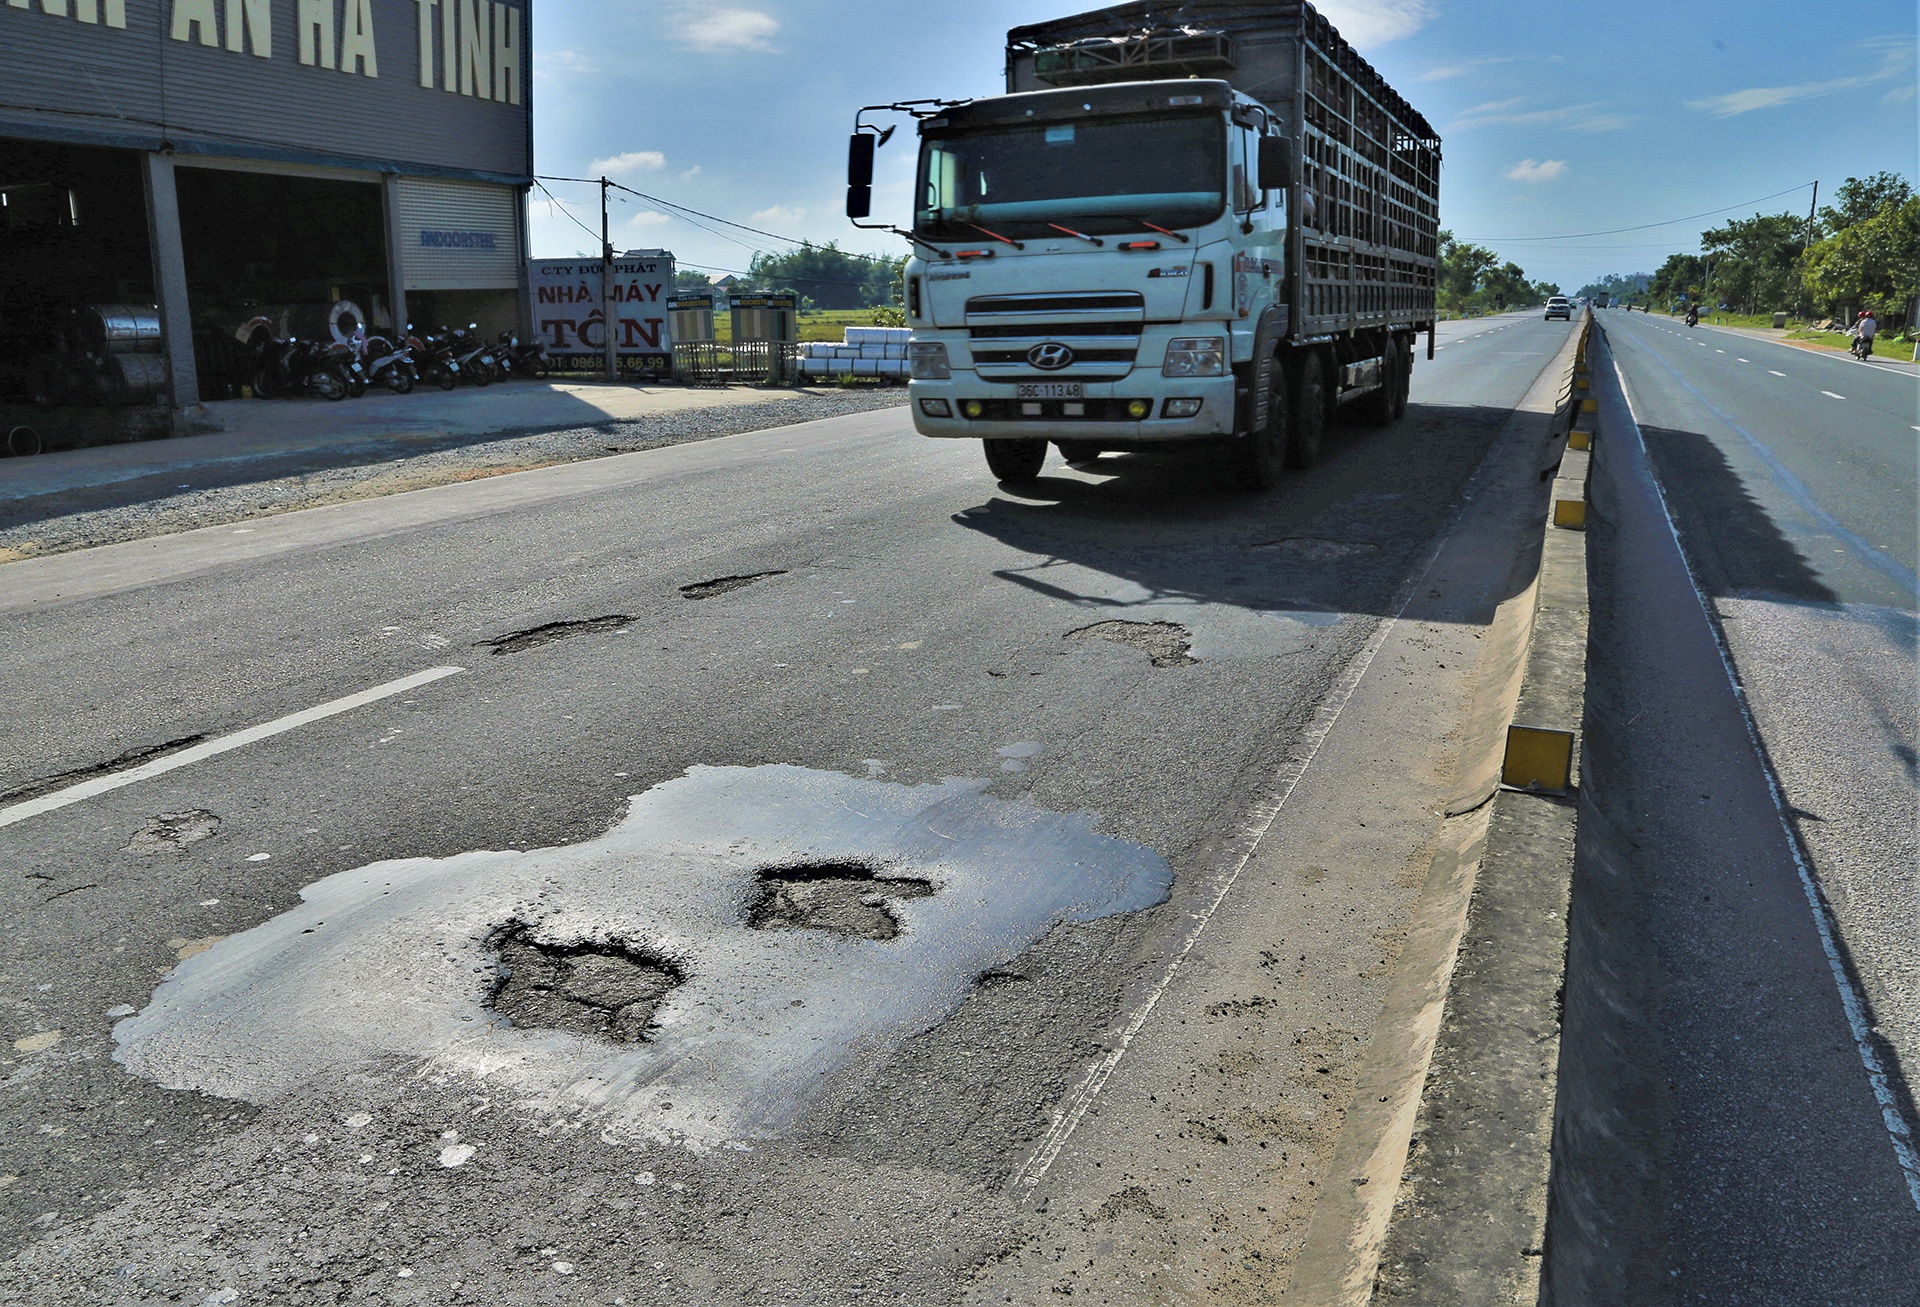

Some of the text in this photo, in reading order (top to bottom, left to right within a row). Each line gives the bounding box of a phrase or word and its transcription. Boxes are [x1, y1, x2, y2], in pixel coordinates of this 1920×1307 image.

[615, 262, 657, 274] PHÁT
[538, 281, 593, 304] NHÀ
[541, 308, 664, 348] TÔN
[572, 357, 664, 368] 0968.5.66.99
